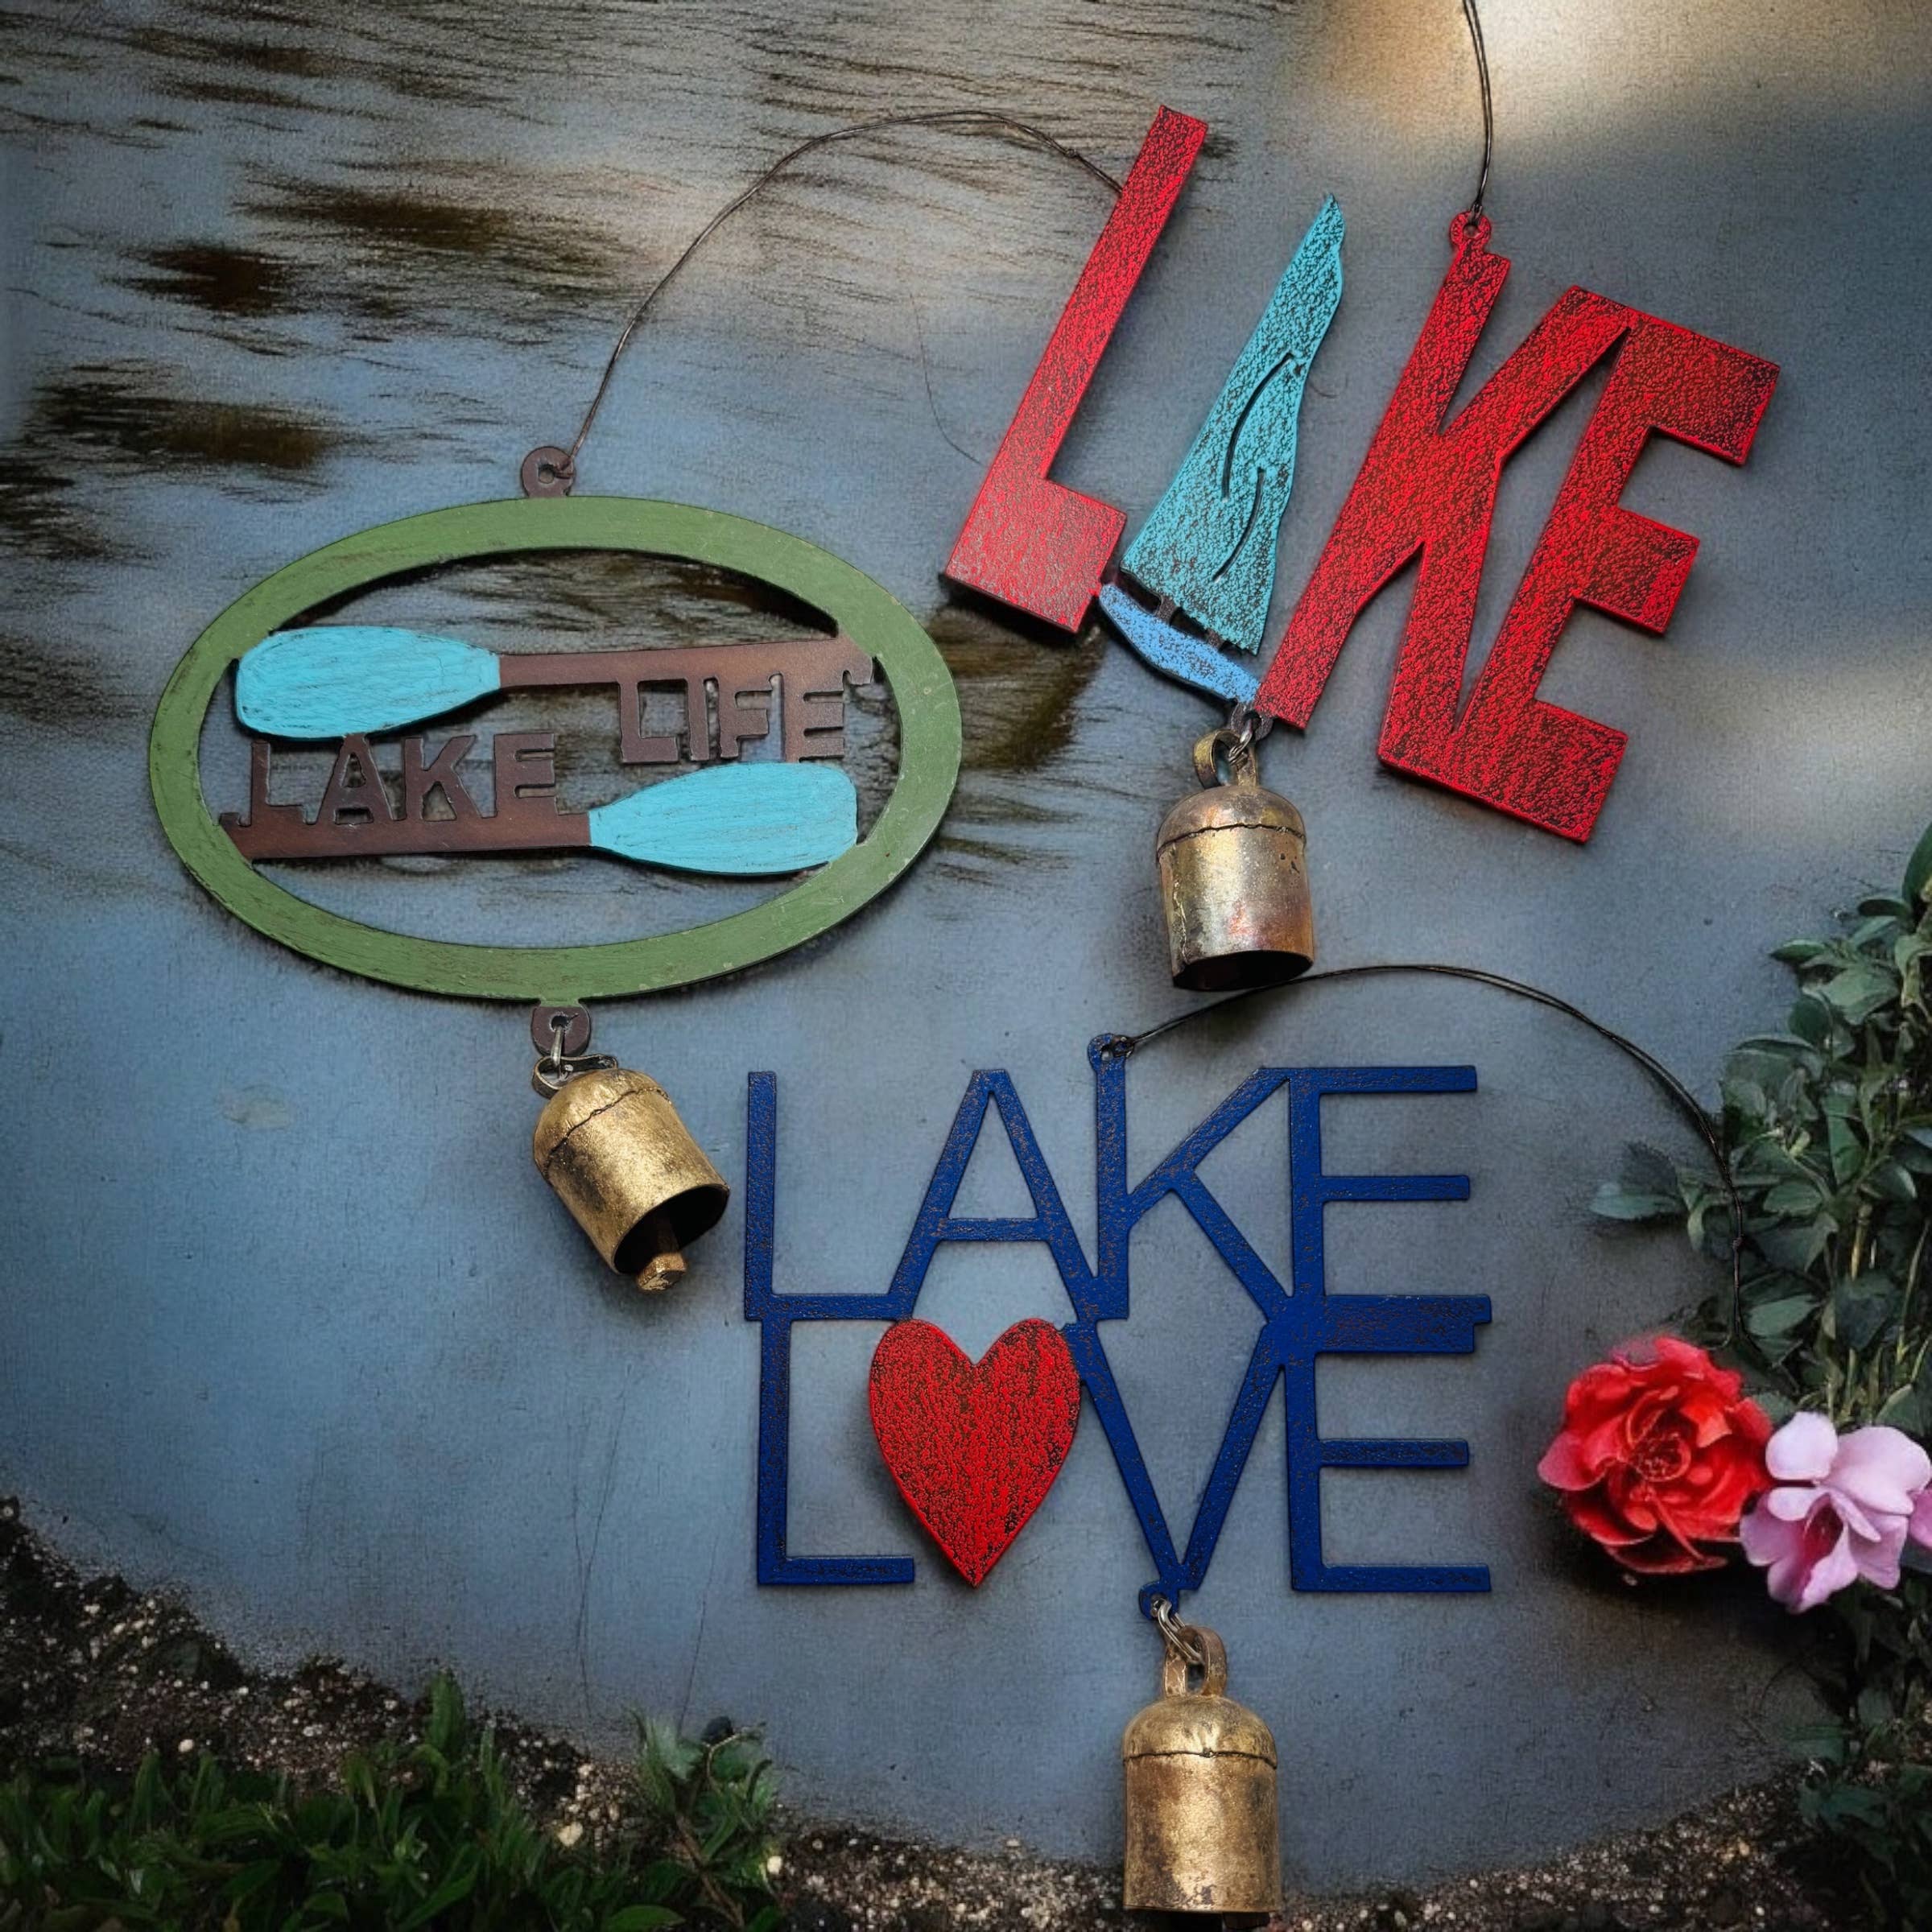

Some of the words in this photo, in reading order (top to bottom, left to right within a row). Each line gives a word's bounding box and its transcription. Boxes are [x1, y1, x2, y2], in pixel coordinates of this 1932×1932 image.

[249, 731, 556, 824] LAKE
[618, 673, 845, 765] LIFE
[745, 1064, 1491, 1321] LAKE
